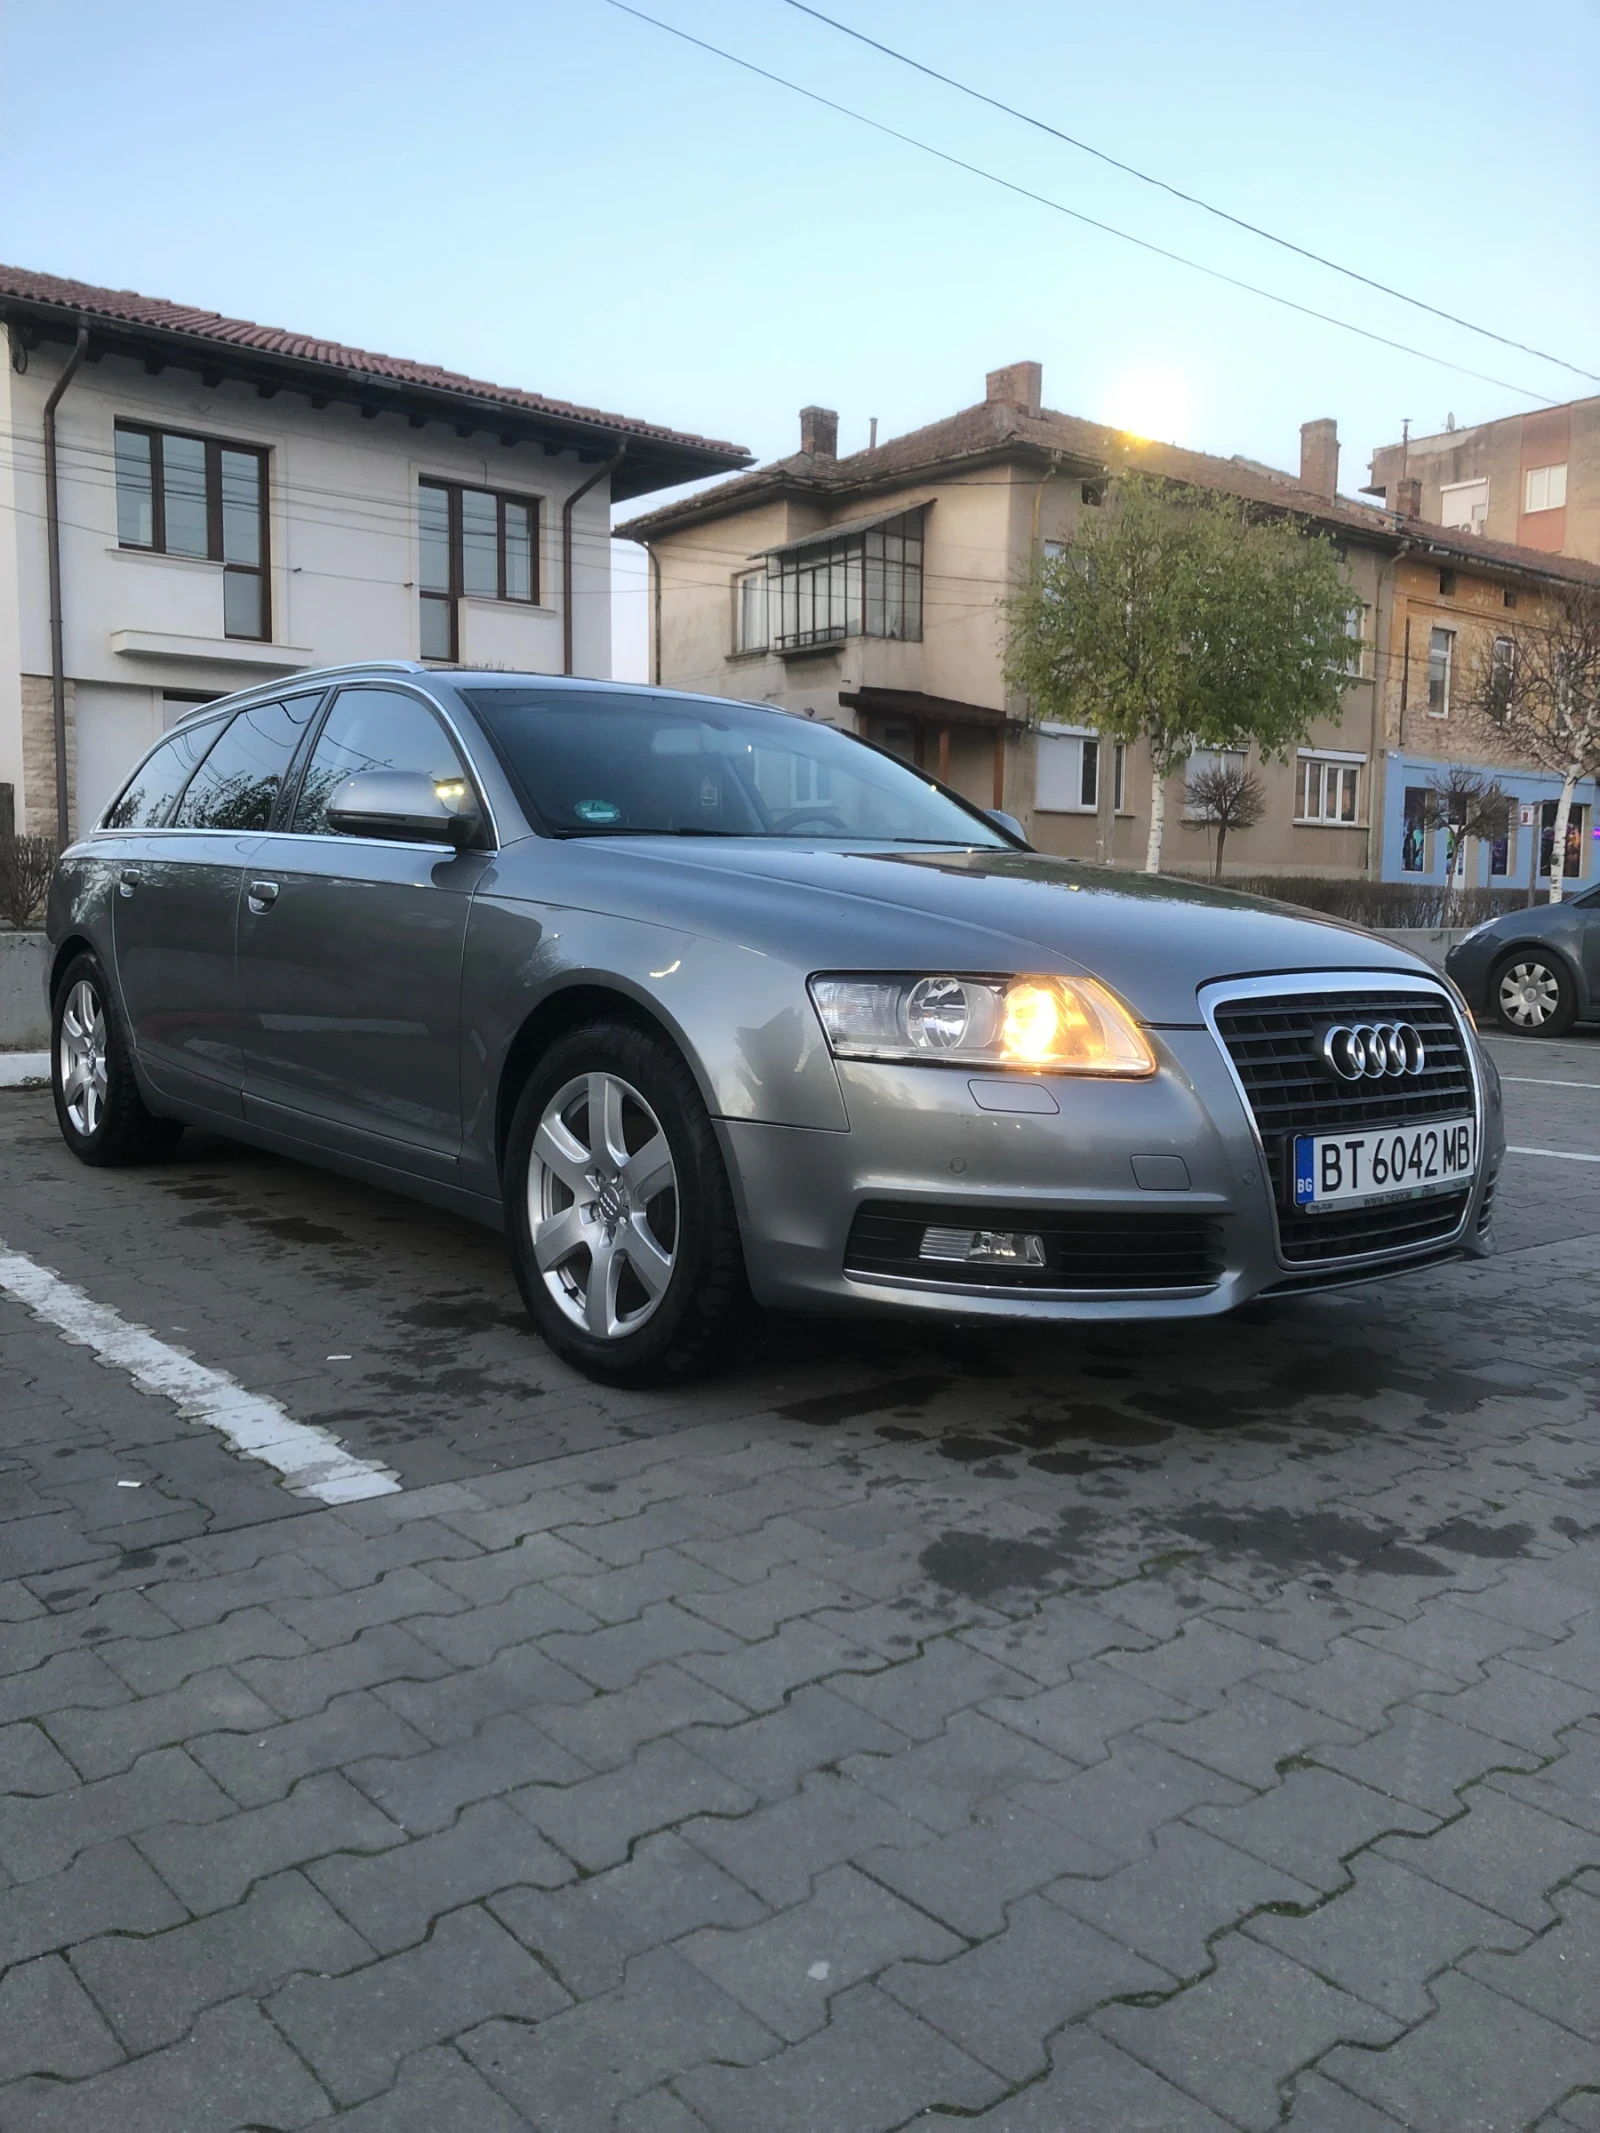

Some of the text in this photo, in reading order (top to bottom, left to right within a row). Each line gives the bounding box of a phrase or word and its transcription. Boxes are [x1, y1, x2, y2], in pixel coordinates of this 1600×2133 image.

[1321, 1125, 1470, 1193] BT 6042 MB
[1297, 1178, 1313, 1194] BG
